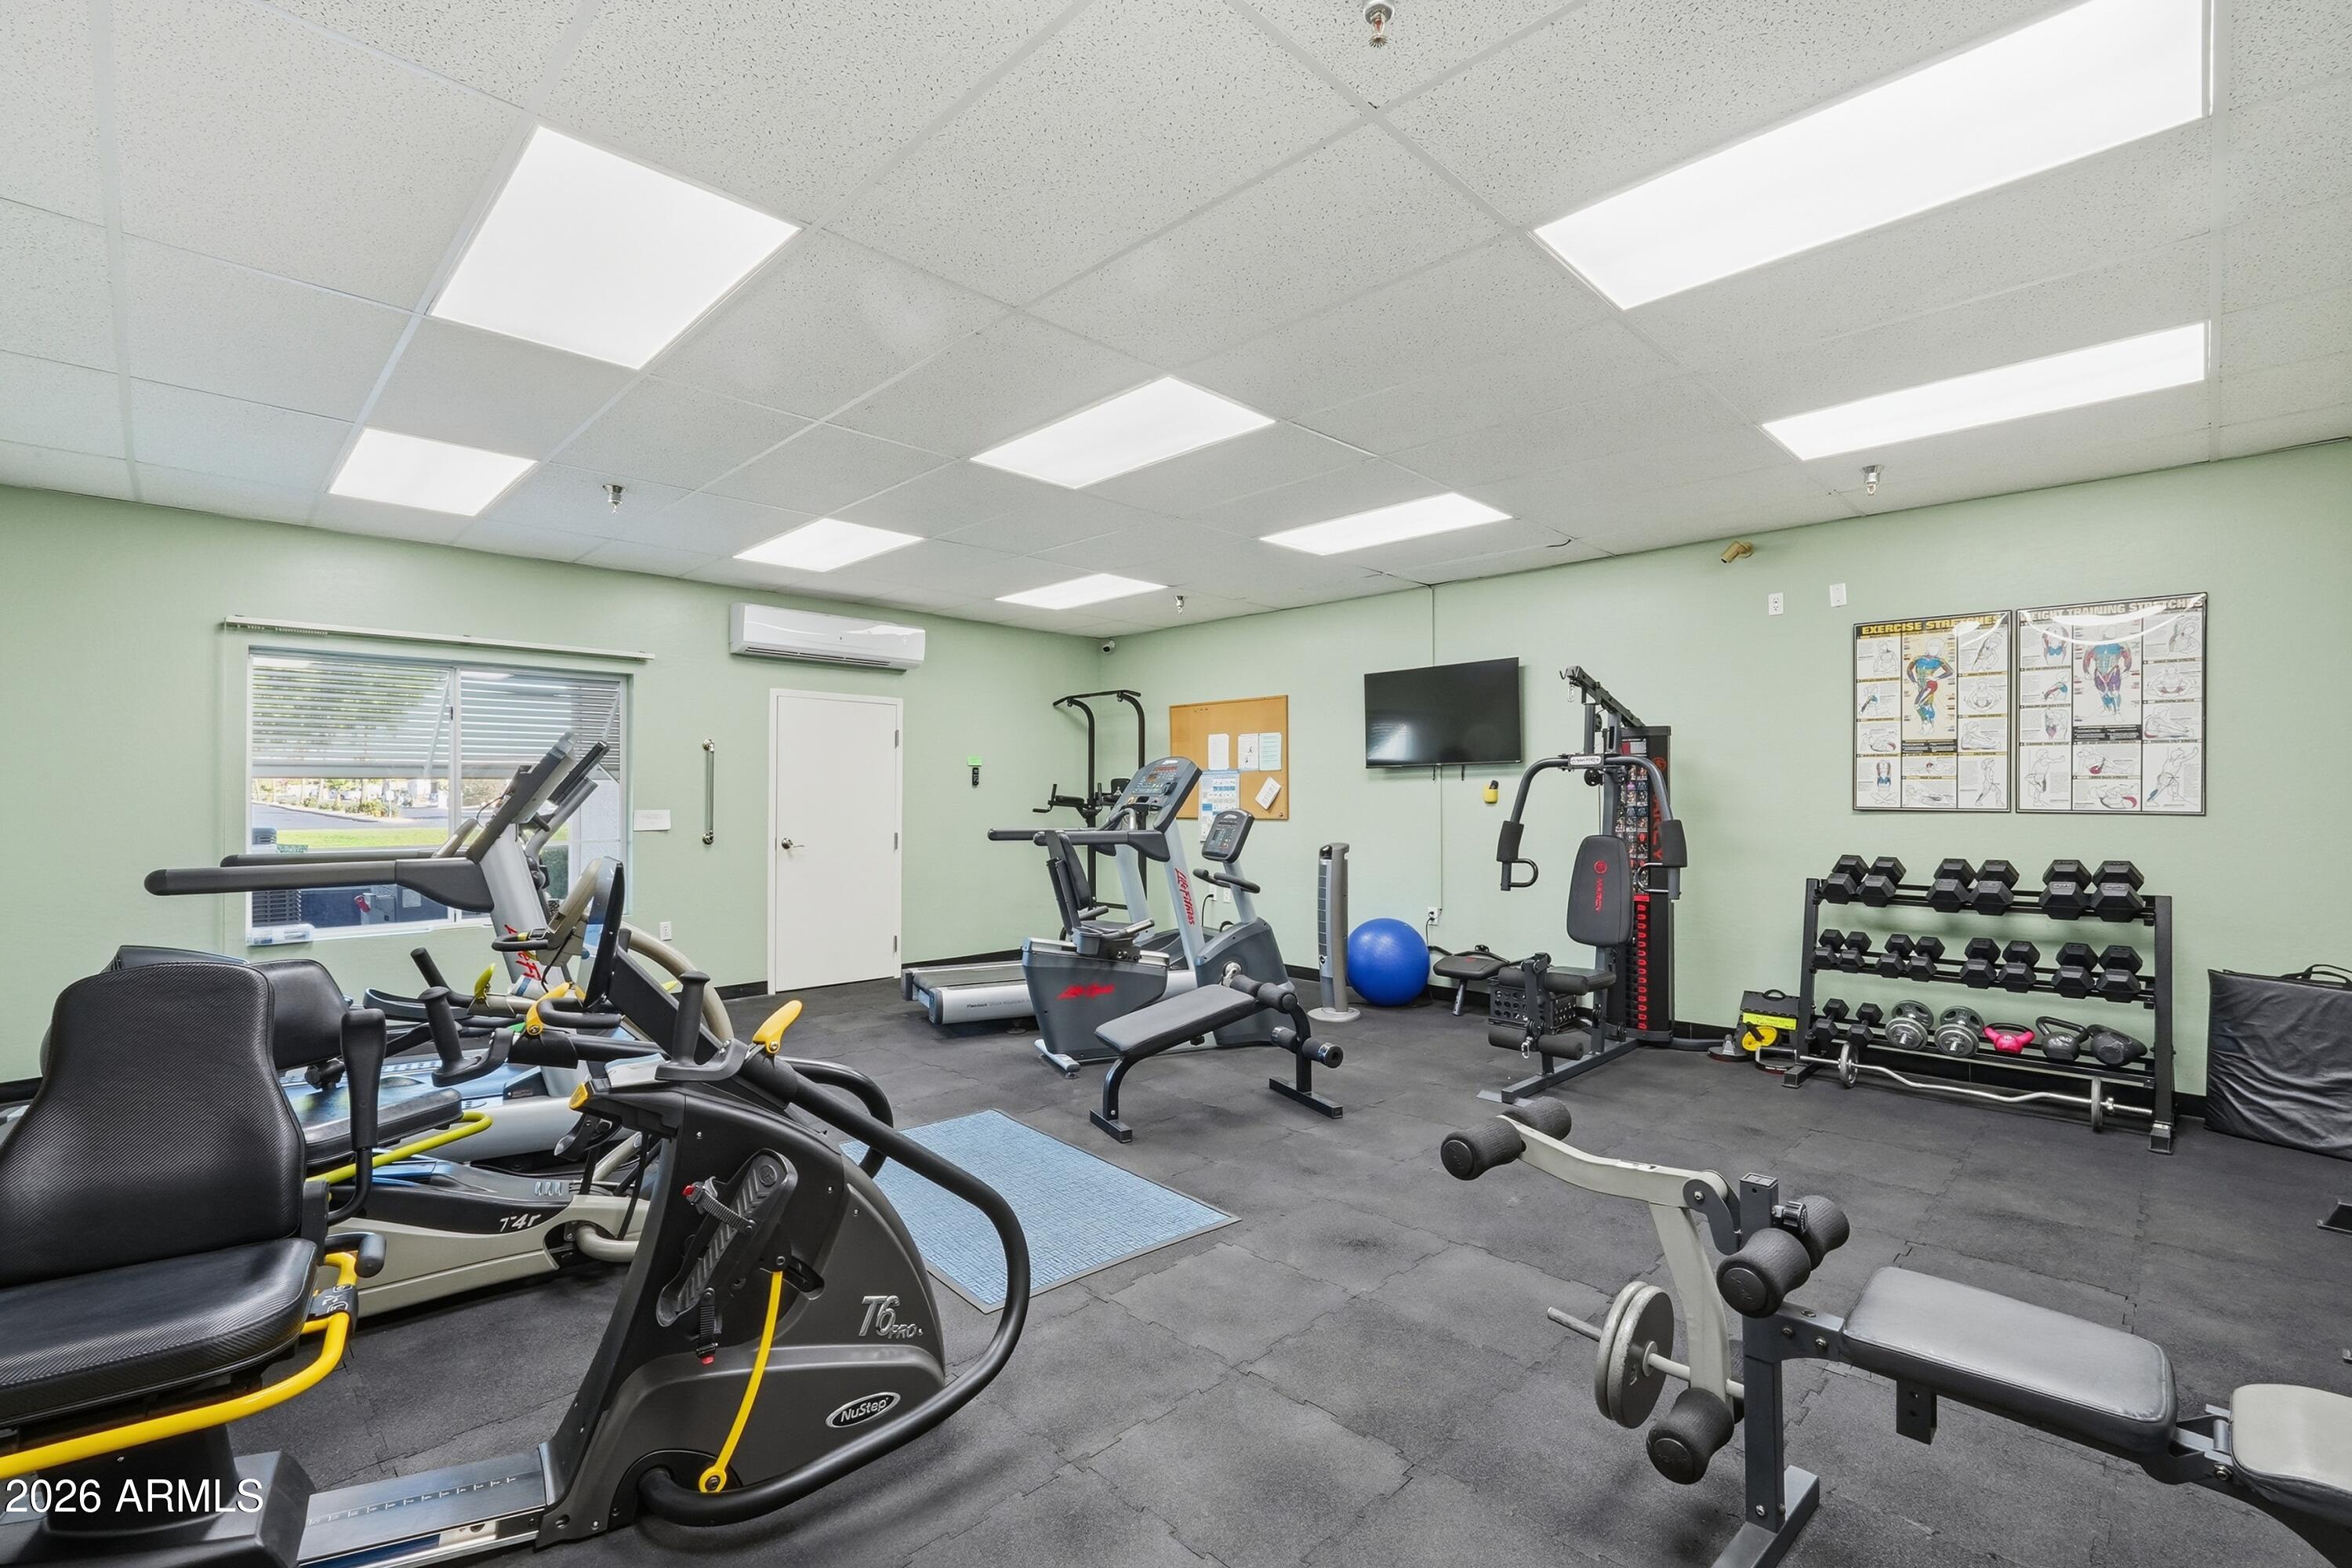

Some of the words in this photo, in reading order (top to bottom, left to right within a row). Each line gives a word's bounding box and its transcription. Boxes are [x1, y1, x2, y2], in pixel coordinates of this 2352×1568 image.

[2067, 603, 2125, 616] TRAINING
[1862, 622, 1922, 635] EXERCISE
[858, 1295, 900, 1336] T6
[887, 1323, 917, 1339] PRO
[840, 1399, 887, 1423] NuStep
